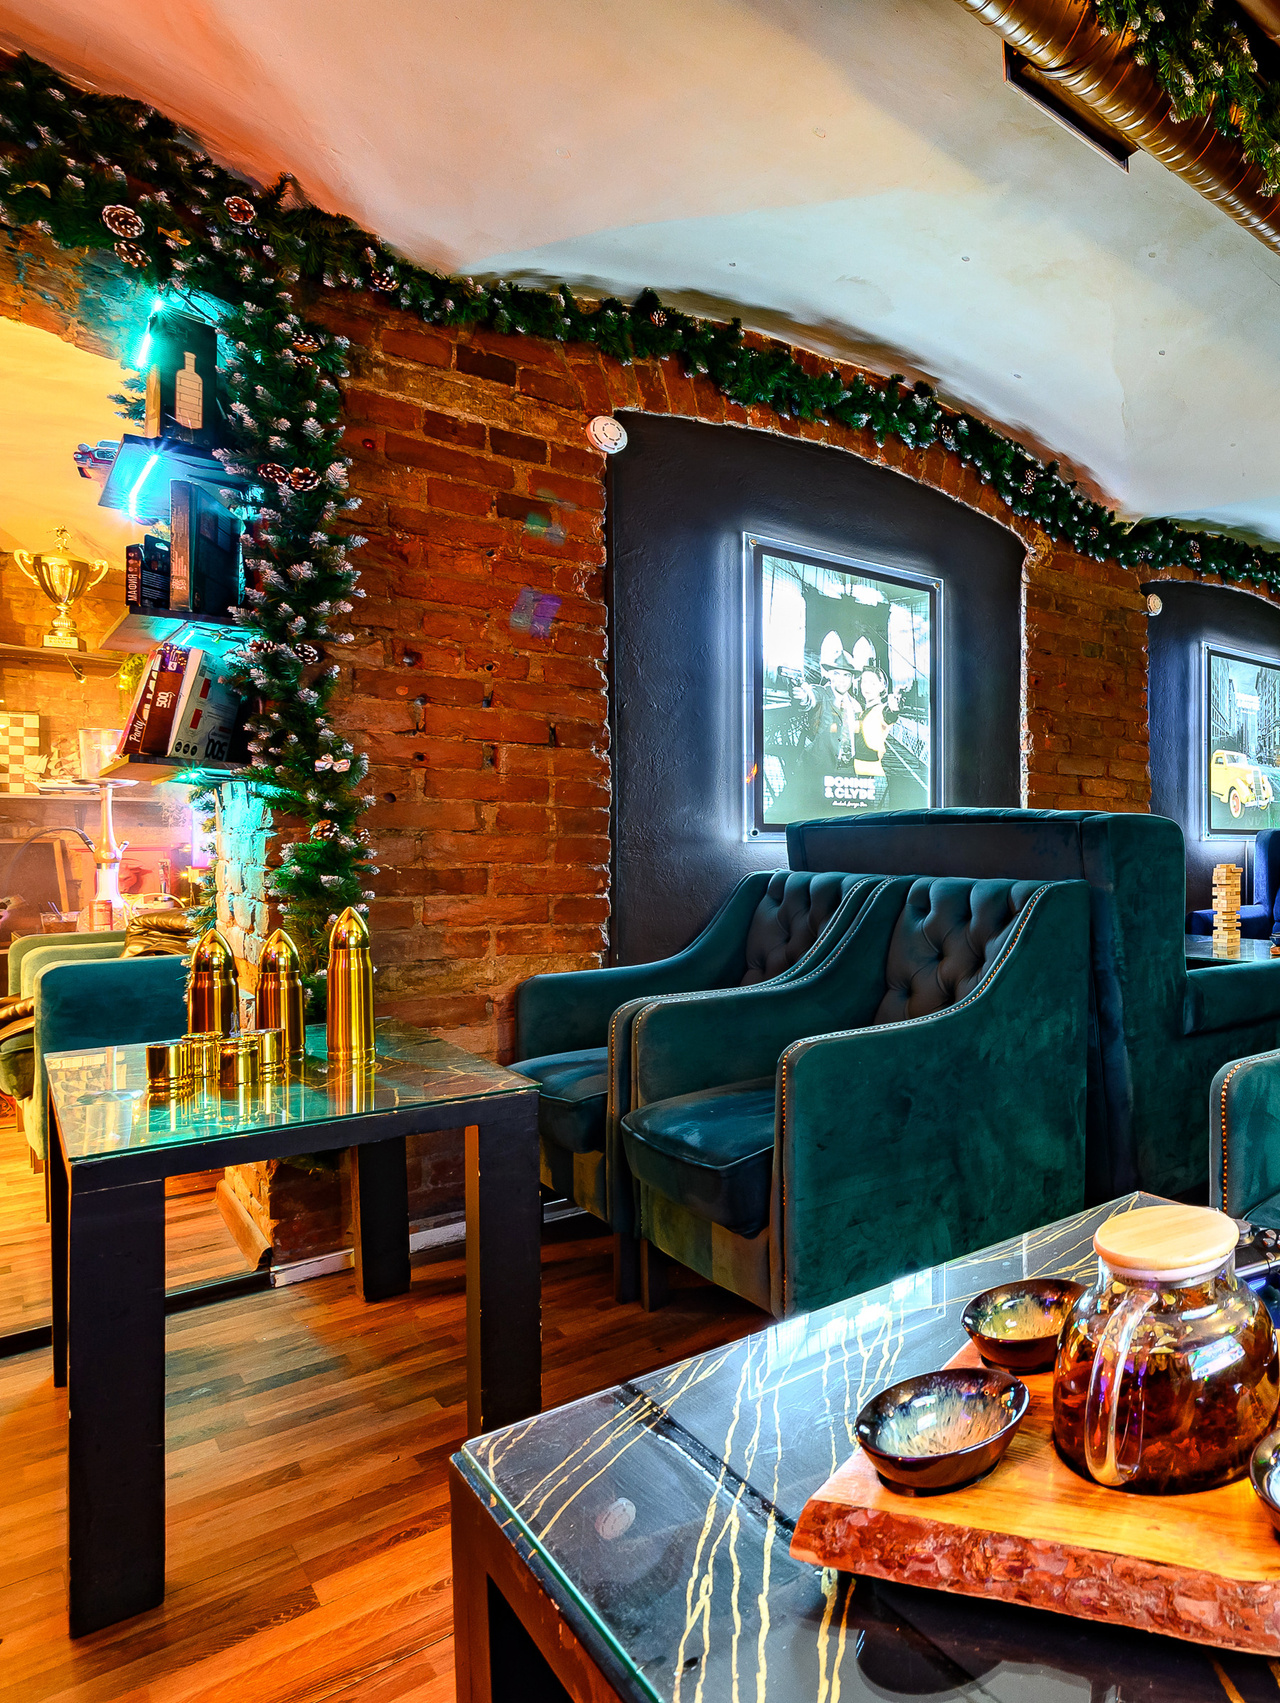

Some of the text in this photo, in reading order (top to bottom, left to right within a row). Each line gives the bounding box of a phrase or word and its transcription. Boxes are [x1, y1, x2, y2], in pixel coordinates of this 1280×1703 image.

[127, 573, 138, 602] МАФИЯ
[155, 691, 173, 708] 500
[129, 720, 146, 742] Party
[824, 776, 876, 789] BONNIE
[824, 787, 876, 800] & CLYDE
